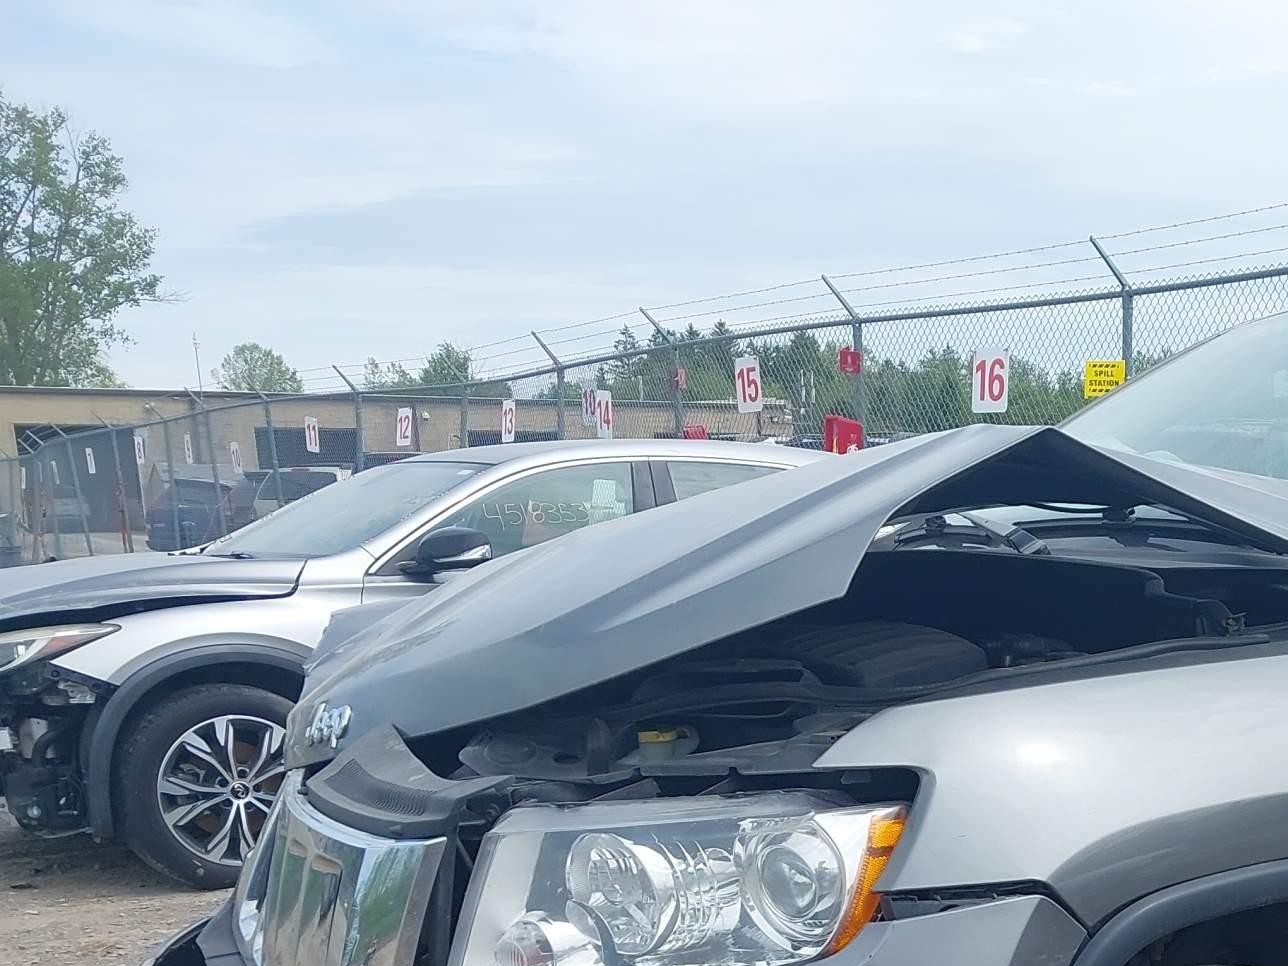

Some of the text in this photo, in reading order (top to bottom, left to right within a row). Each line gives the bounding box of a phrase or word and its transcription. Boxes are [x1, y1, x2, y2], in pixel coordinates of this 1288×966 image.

[737, 366, 759, 404] 15
[975, 358, 1005, 401] 16
[1088, 379, 1120, 387] STATION
[1093, 370, 1114, 378] SPILL
[398, 414, 411, 439] 12
[503, 407, 514, 435] 13
[597, 400, 611, 430] 14
[306, 423, 318, 447] 11
[305, 702, 352, 748] Jeep
